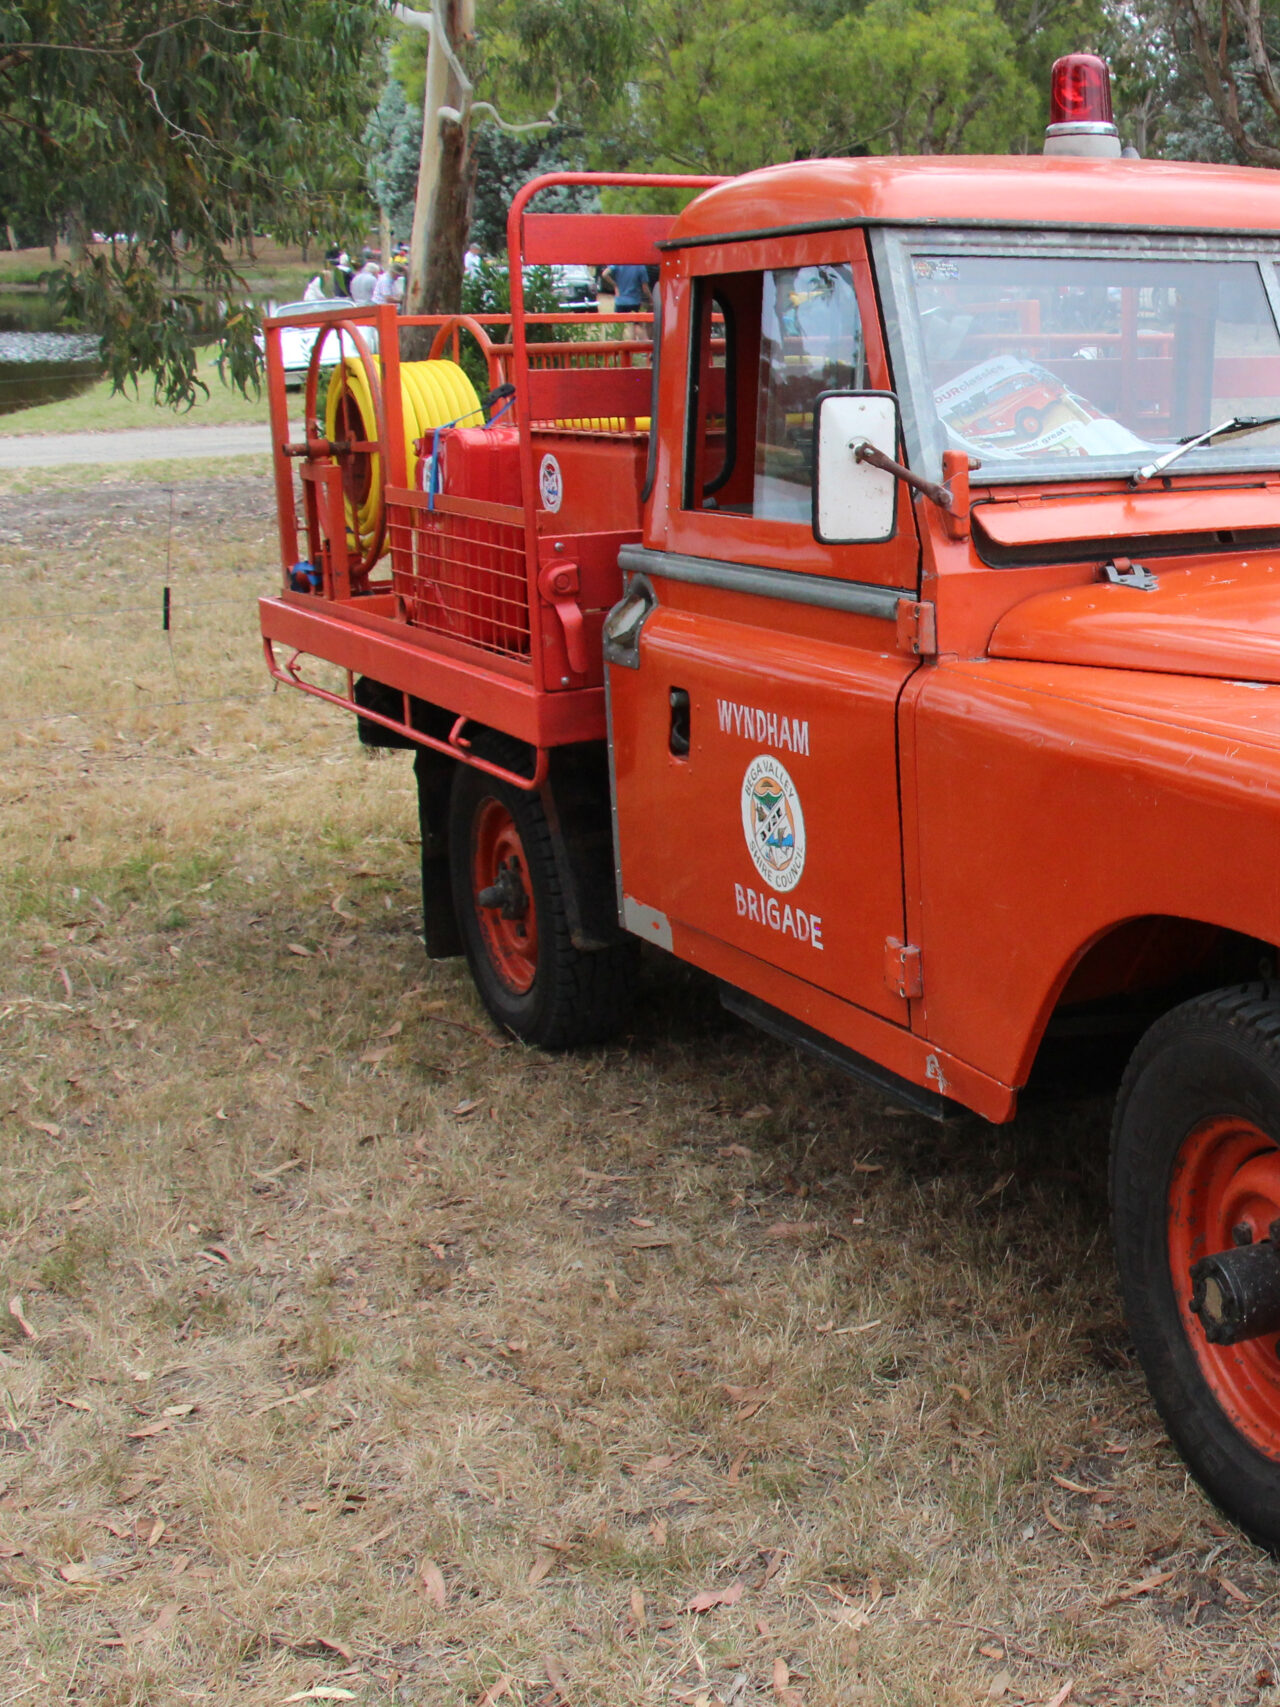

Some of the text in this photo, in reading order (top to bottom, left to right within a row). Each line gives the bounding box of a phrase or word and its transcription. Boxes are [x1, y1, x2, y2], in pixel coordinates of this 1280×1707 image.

[717, 699, 809, 756] WYNDHAM
[745, 760, 795, 798] BEGA VALLEY
[749, 840, 804, 888] SHIRE COUNCIL
[734, 883, 824, 950] BRIGADE
